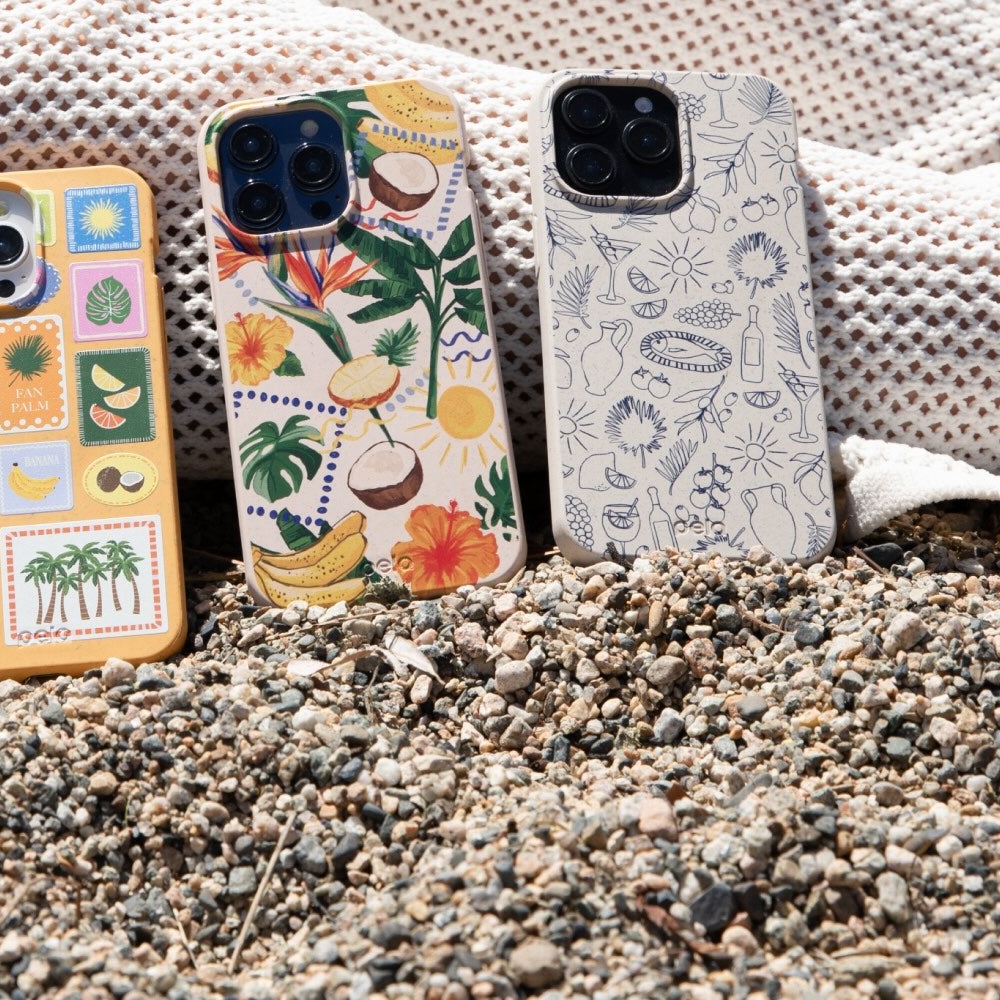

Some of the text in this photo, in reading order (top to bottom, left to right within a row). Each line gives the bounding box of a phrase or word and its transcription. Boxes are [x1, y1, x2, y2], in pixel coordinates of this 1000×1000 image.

[15, 387, 43, 399] FAN
[11, 400, 49, 413] PALM
[23, 455, 59, 467] BANANA
